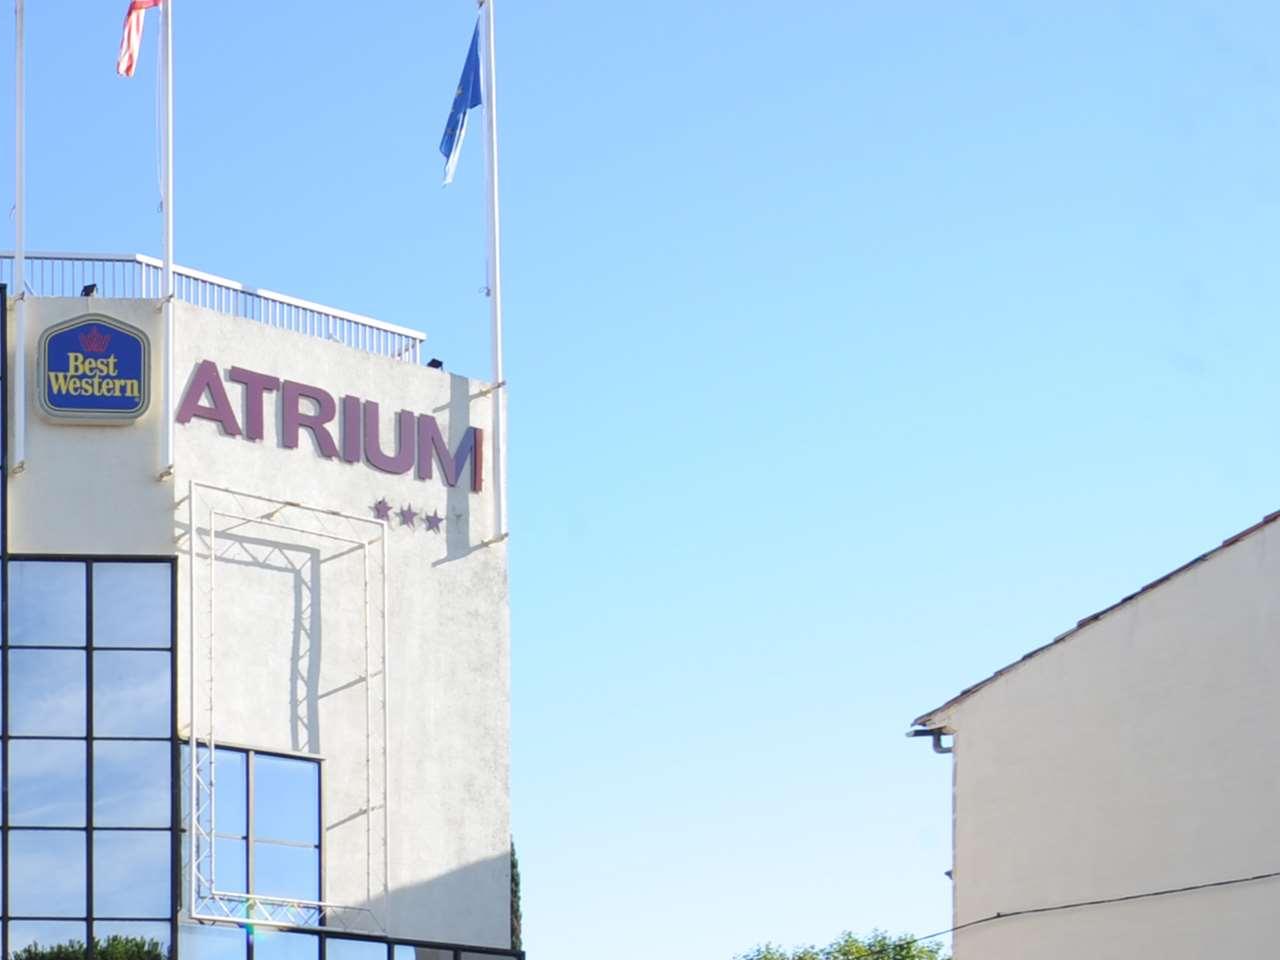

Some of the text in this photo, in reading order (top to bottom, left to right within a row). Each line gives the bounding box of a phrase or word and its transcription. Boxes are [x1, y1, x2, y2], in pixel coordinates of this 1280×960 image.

[67, 352, 118, 377] Best
[48, 371, 140, 397] Western
[176, 359, 483, 492] ATRIUM
